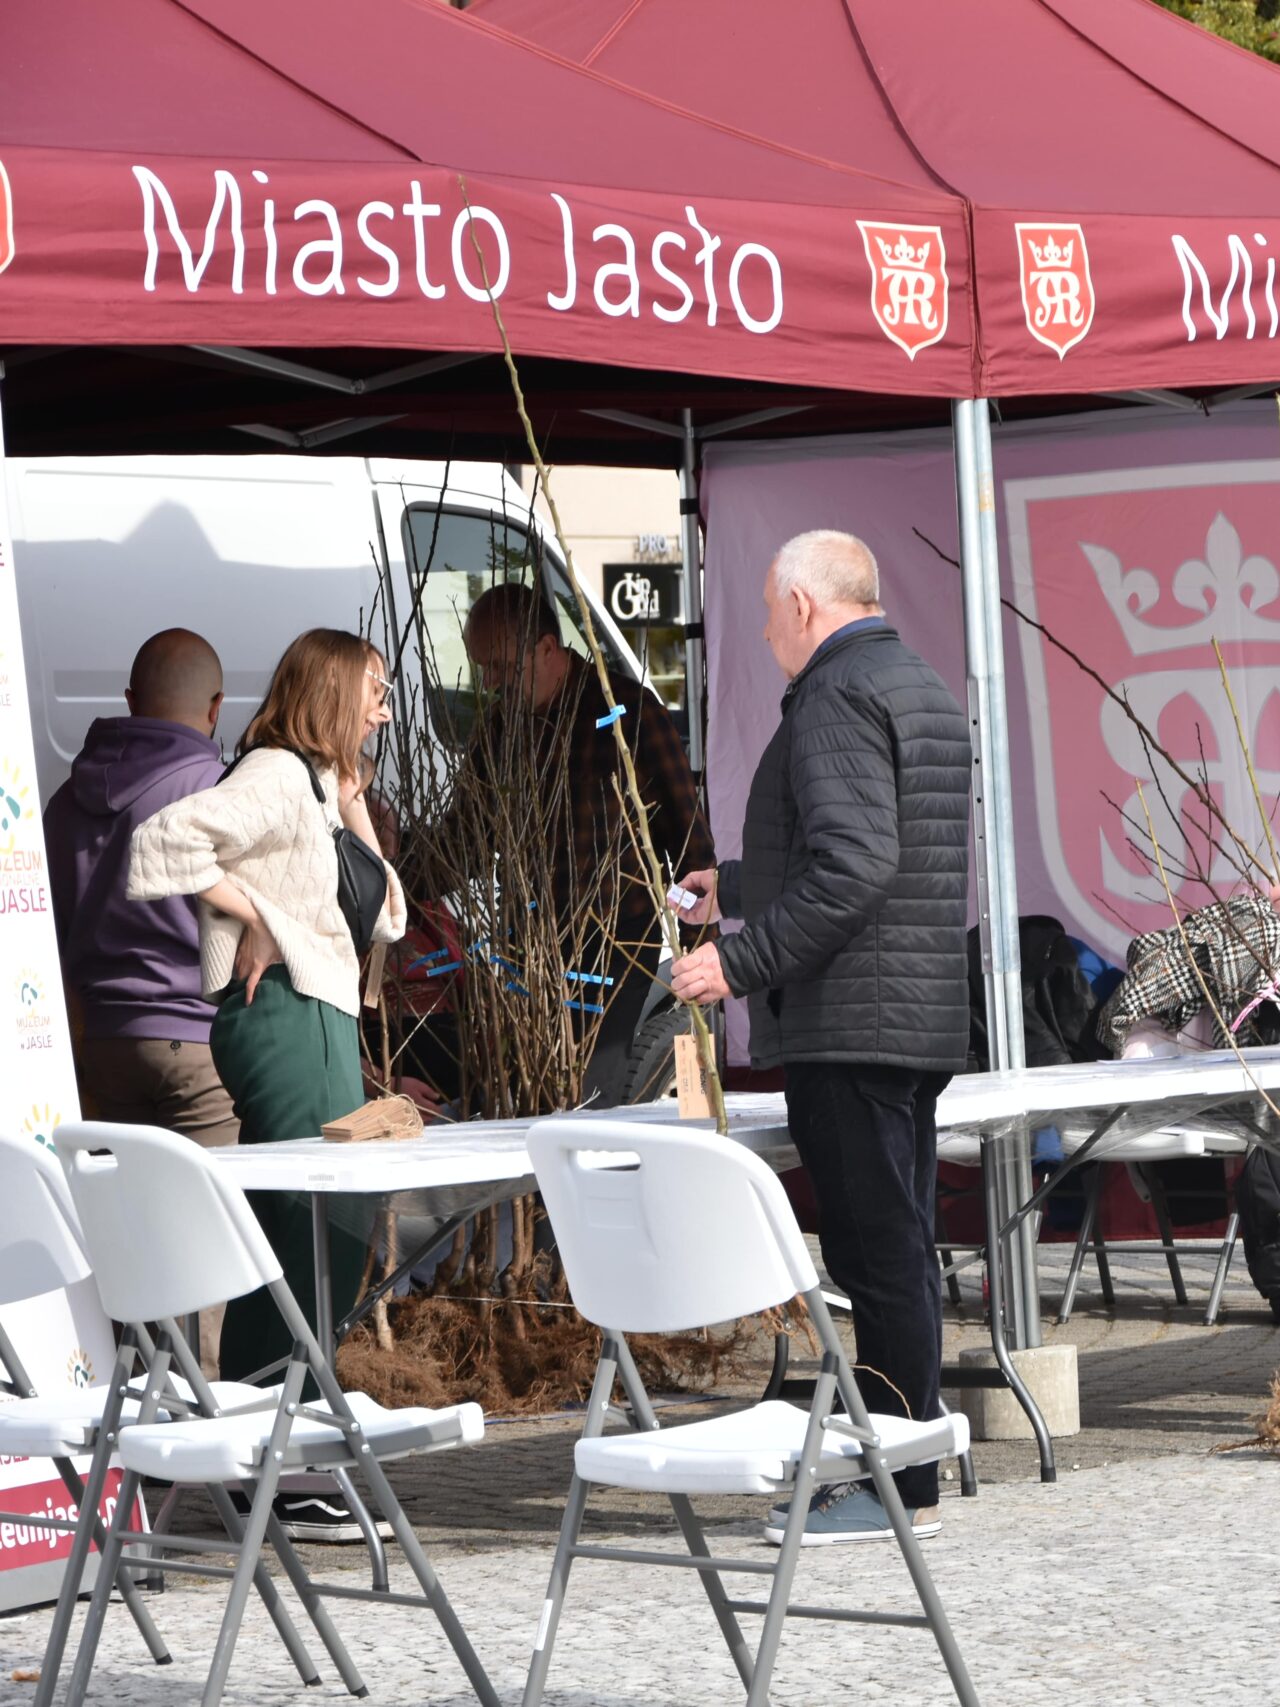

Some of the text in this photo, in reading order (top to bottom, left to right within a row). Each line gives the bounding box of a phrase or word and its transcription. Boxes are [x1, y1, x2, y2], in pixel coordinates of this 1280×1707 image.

[132, 165, 510, 302] Miasto
[547, 193, 783, 333] Jasło
[0, 850, 42, 871] ZEUM
